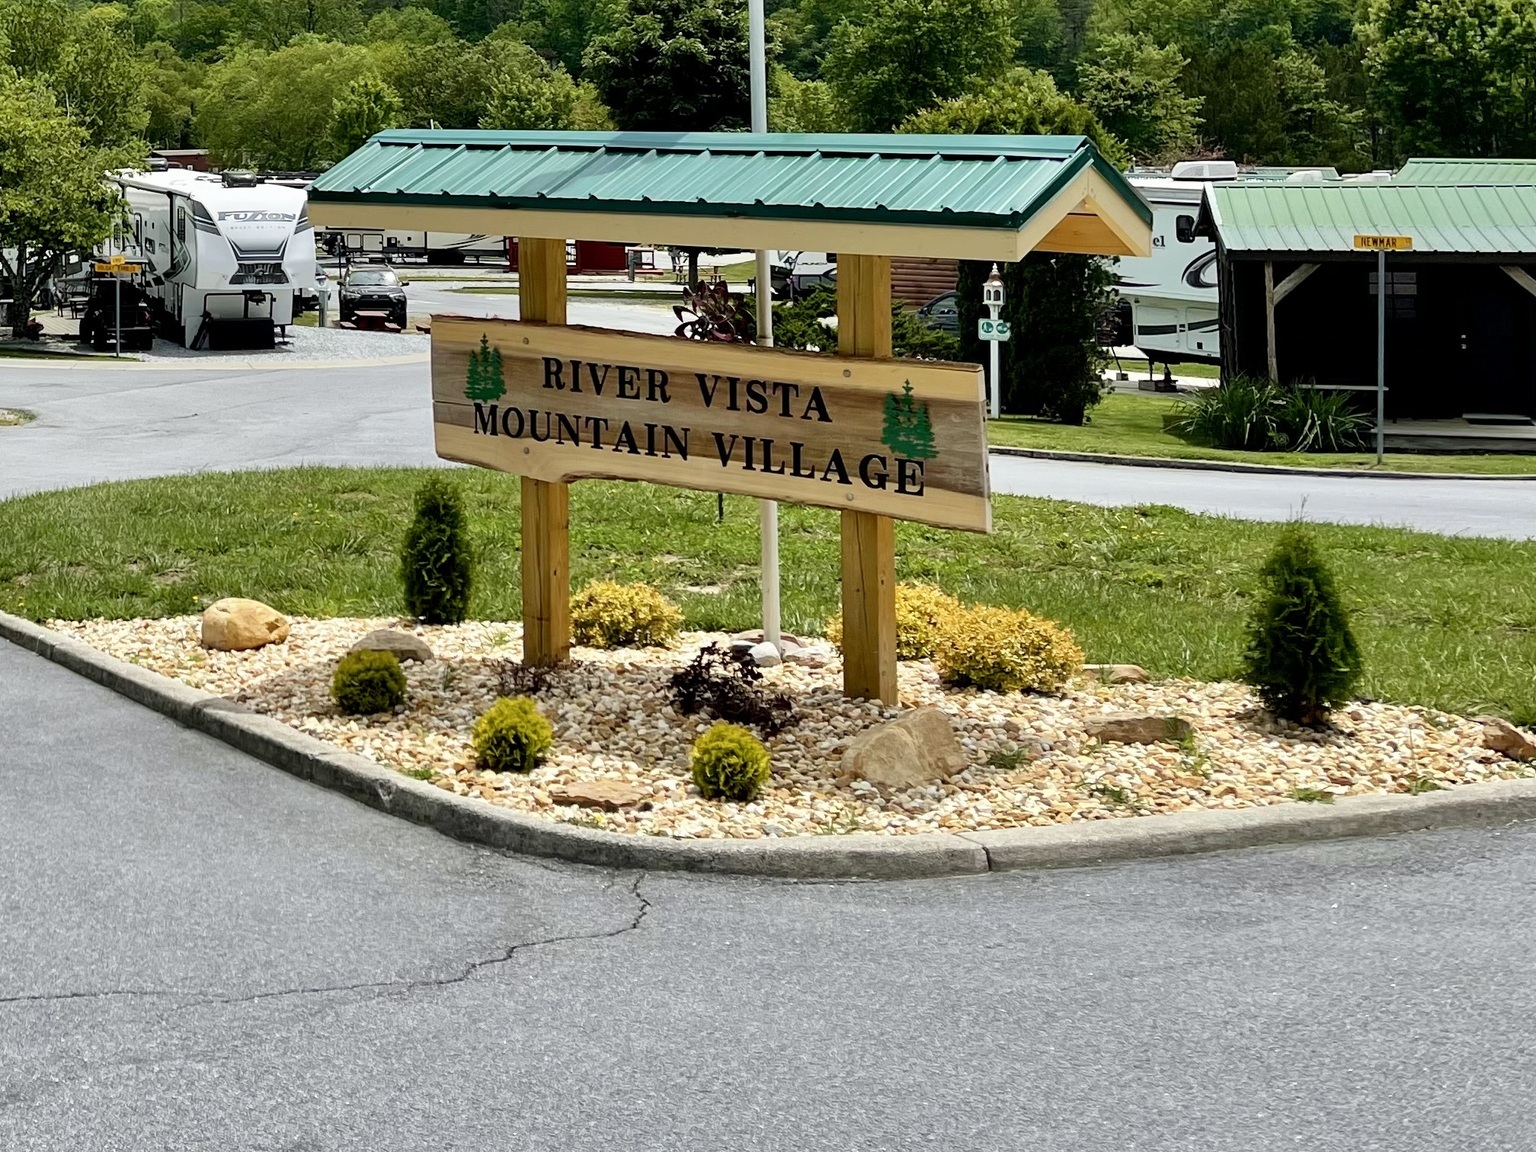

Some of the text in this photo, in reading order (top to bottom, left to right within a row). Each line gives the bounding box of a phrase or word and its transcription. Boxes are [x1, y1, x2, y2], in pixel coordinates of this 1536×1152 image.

[1360, 237, 1396, 247] NEWMAR
[542, 356, 833, 423] RIVER VISTA
[474, 403, 925, 497] MOUNTAIN VILLAGE
